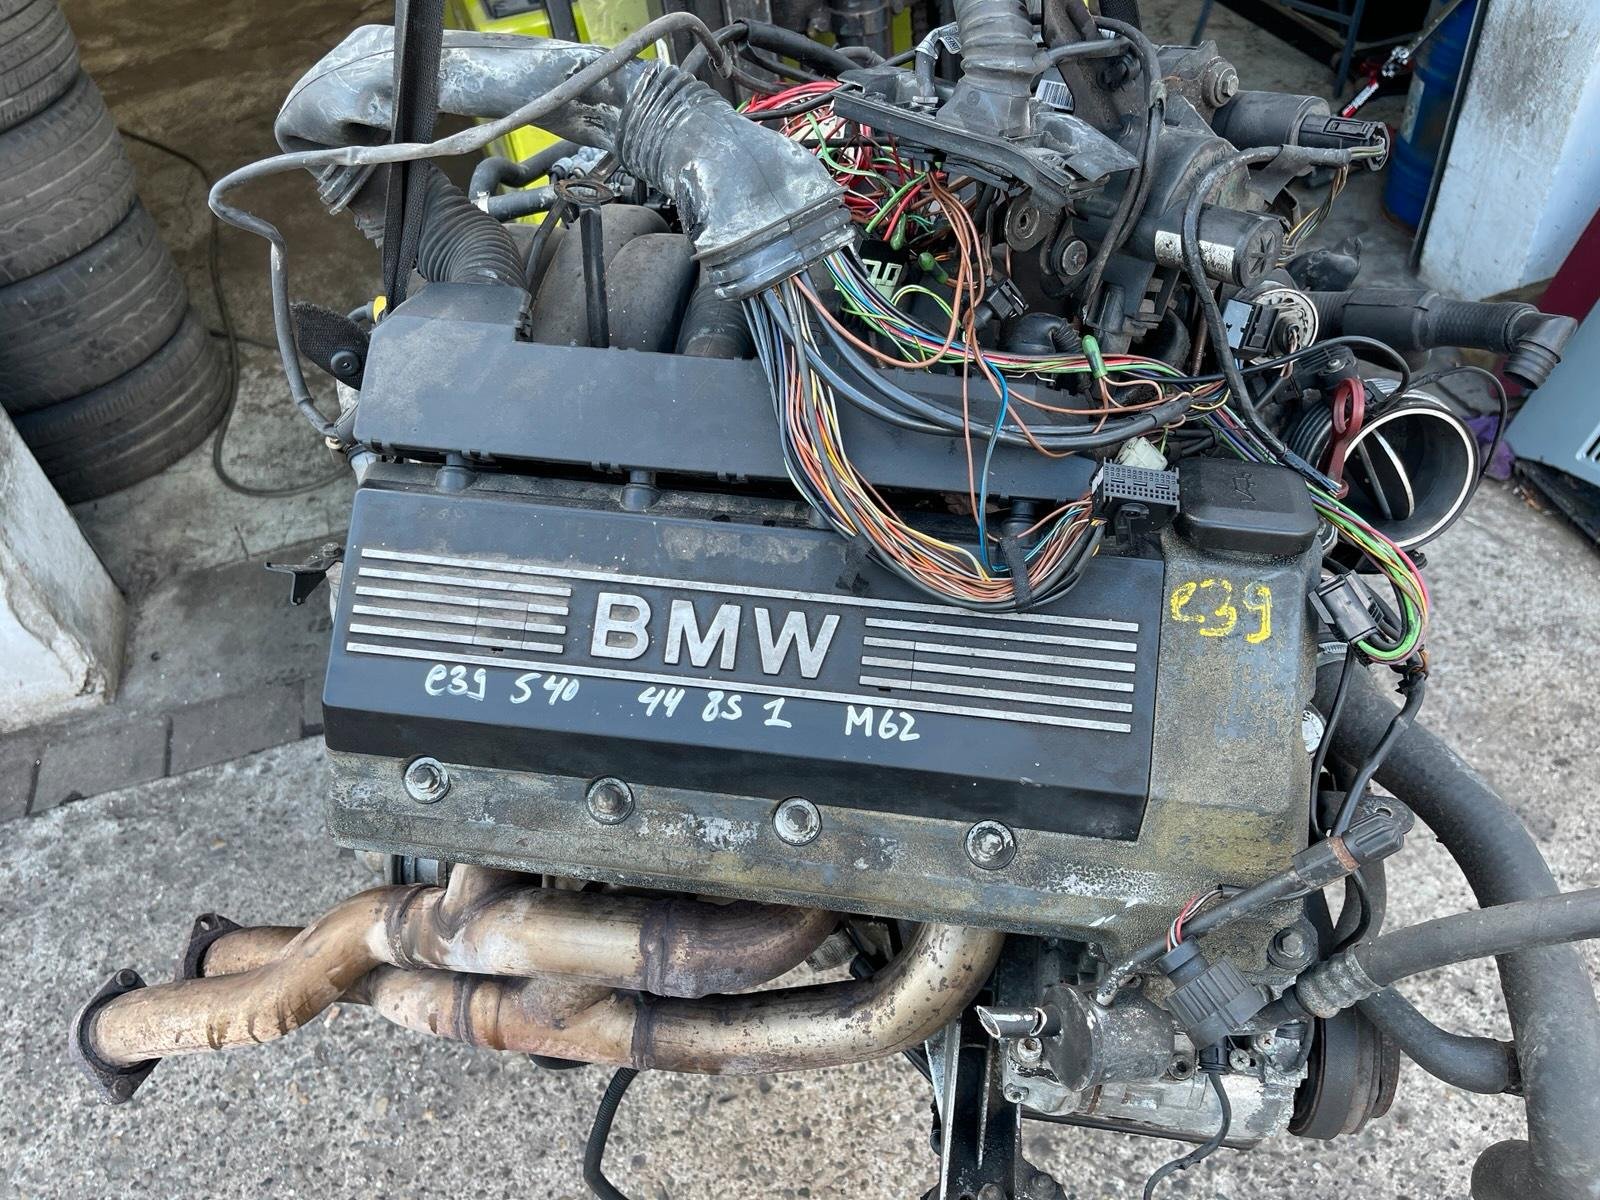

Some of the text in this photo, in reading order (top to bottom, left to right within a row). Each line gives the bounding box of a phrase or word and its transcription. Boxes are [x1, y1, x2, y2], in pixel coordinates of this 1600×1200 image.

[590, 592, 841, 679] BMW
[638, 686, 685, 717] 44
[845, 705, 920, 741] M62
